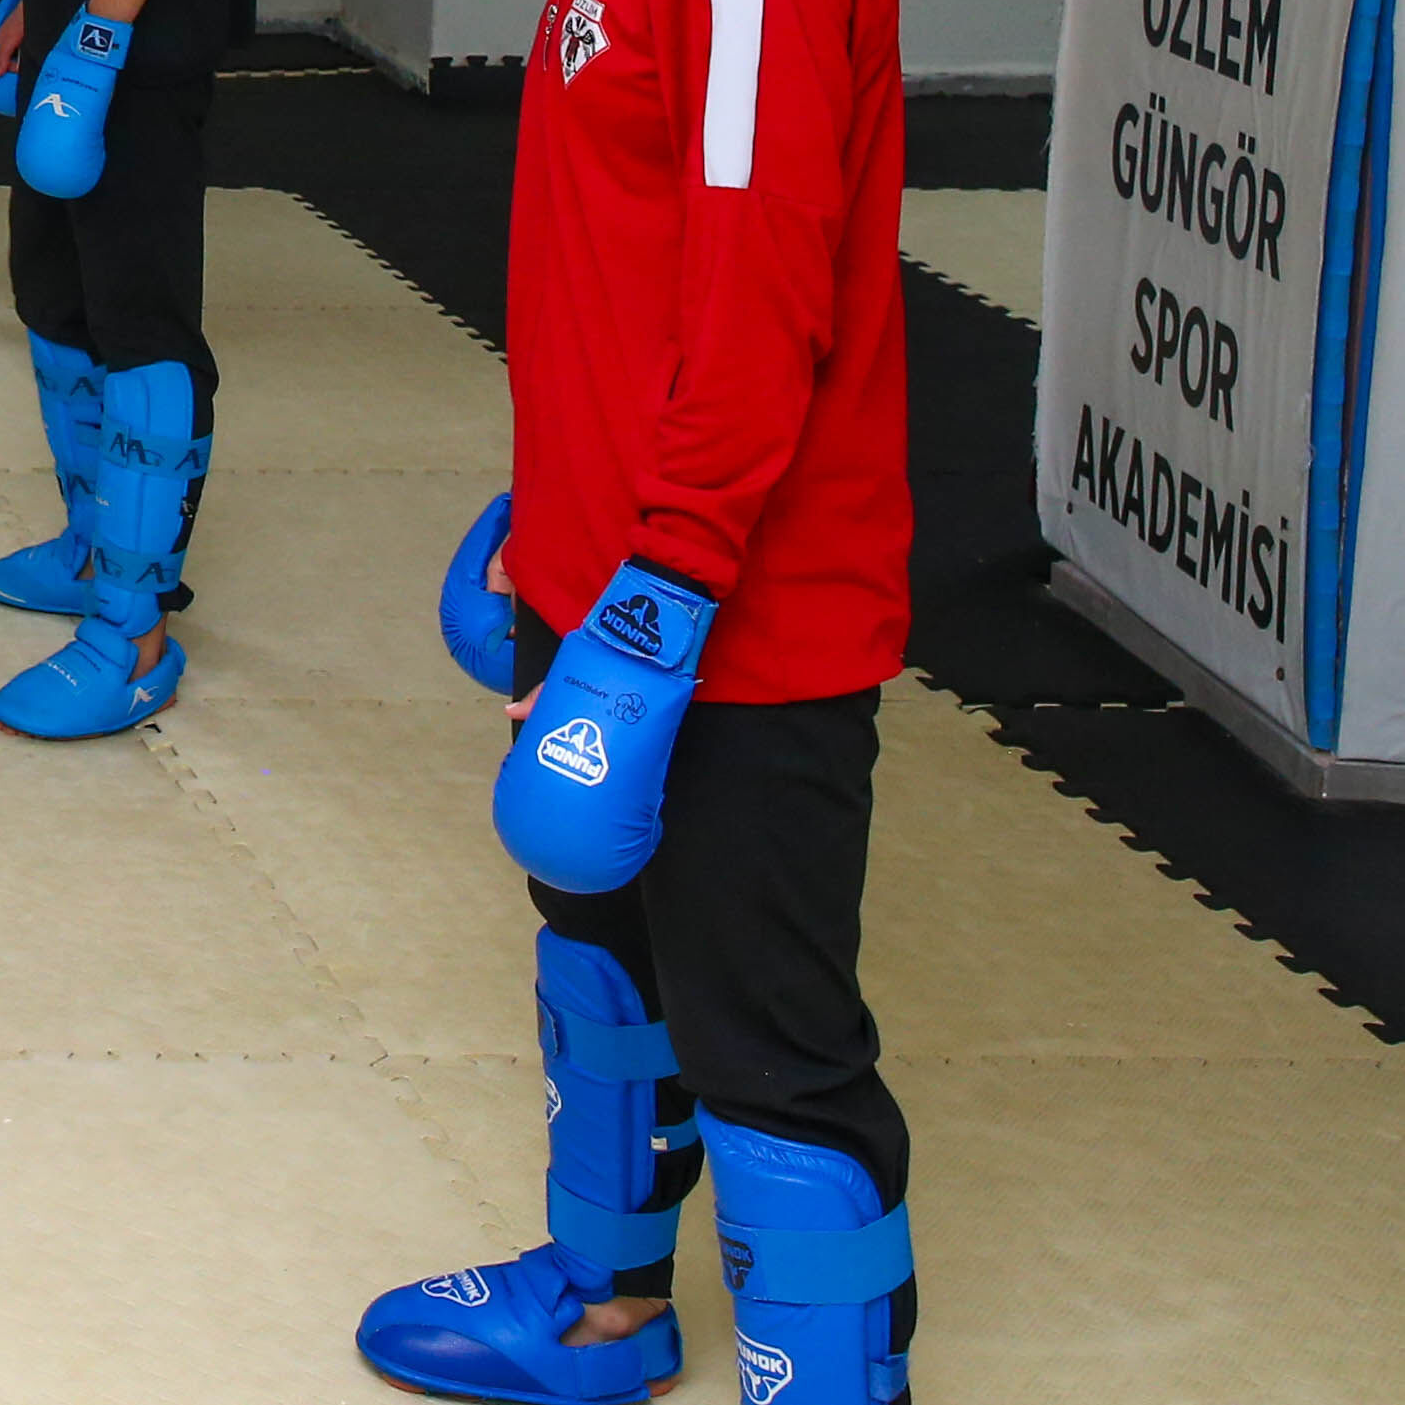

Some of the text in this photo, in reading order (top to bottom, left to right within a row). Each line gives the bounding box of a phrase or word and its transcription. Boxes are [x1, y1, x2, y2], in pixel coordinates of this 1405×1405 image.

[1112, 92, 1287, 283] GÜNGÖR
[1130, 276, 1239, 433] SPOR
[1072, 403, 1289, 645] AKADEMİSİ
[601, 607, 662, 656] PUNOK
[543, 740, 603, 778] PUNOK
